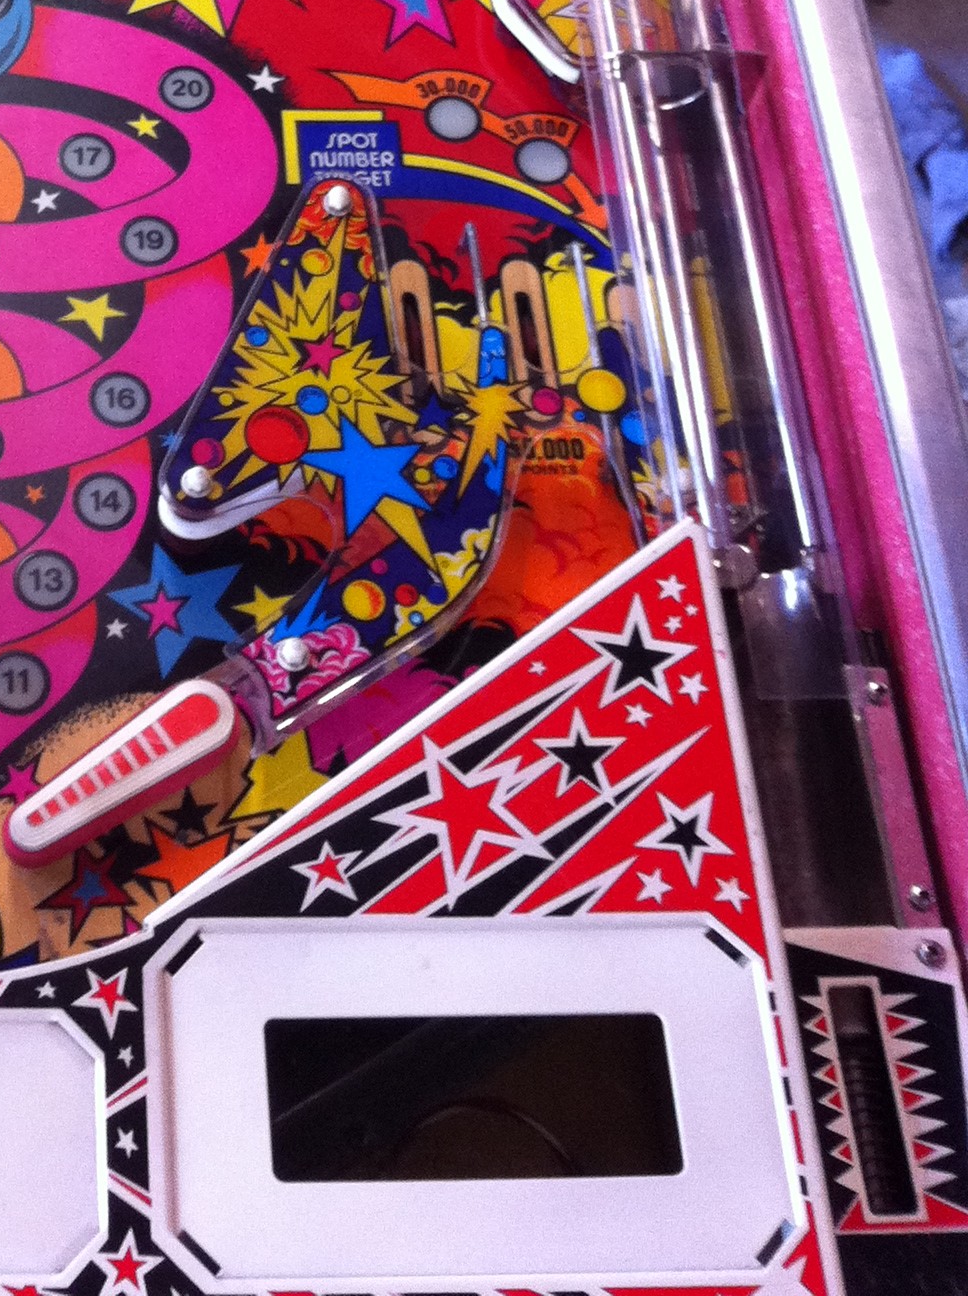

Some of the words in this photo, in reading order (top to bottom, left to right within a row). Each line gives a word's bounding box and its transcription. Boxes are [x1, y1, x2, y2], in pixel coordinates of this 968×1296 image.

[171, 78, 203, 99] 20
[325, 132, 379, 150] SPOT
[73, 146, 102, 166] 17
[309, 150, 395, 168] NUMBER
[135, 230, 164, 252] 19
[105, 388, 136, 410] 16
[89, 490, 122, 512] 14
[28, 568, 64, 593] 13
[1, 668, 30, 694] 11
